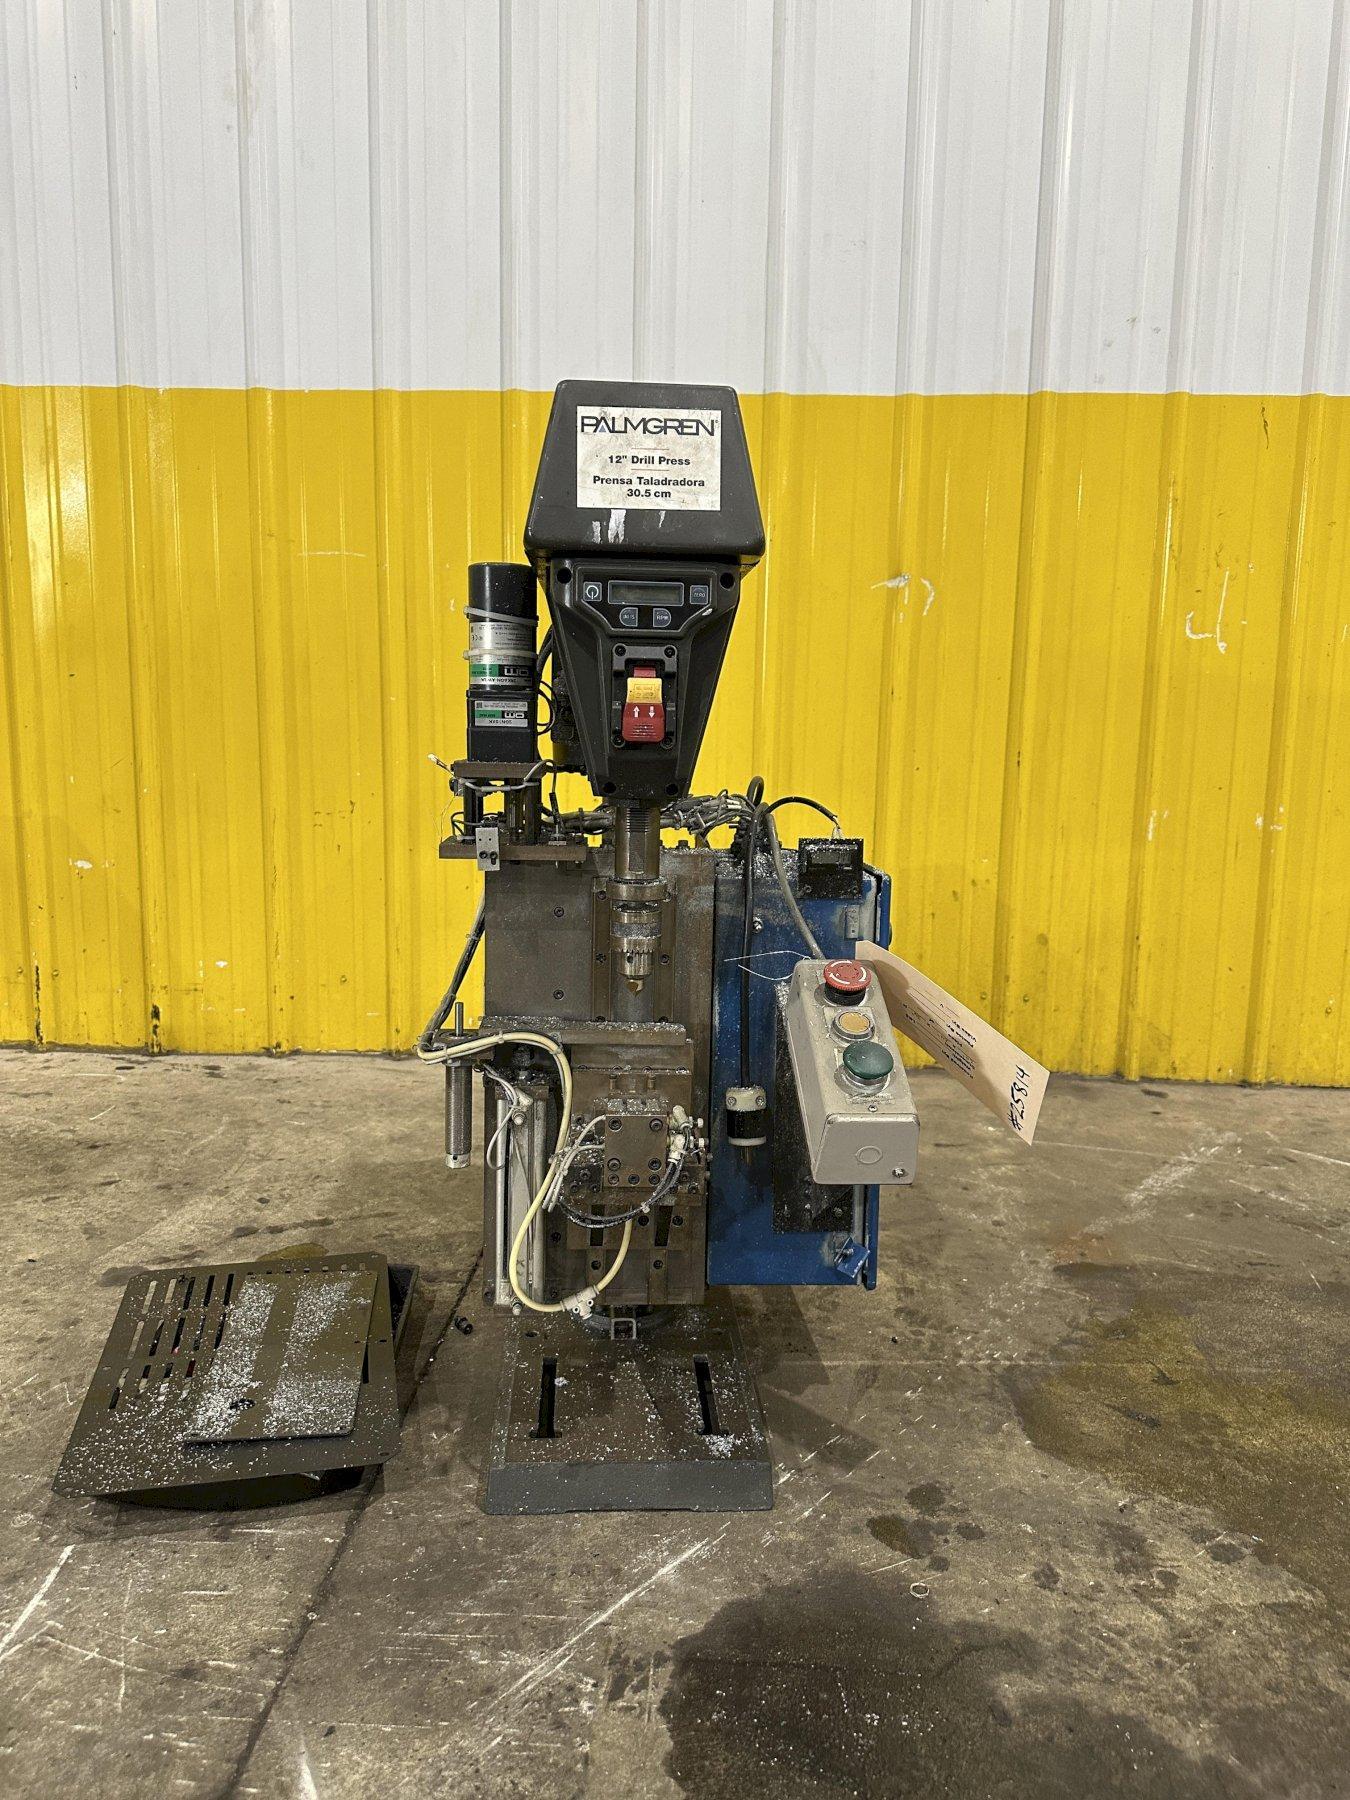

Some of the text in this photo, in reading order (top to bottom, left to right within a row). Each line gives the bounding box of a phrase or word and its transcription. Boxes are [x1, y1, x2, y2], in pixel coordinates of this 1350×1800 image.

[581, 415, 715, 436] PALMGREN
[608, 455, 691, 466] 12" Drill Press
[593, 475, 705, 487] Prensa Taladradora
[626, 488, 672, 498] 30.5 cm
[1007, 1064, 1031, 1131] #25814
